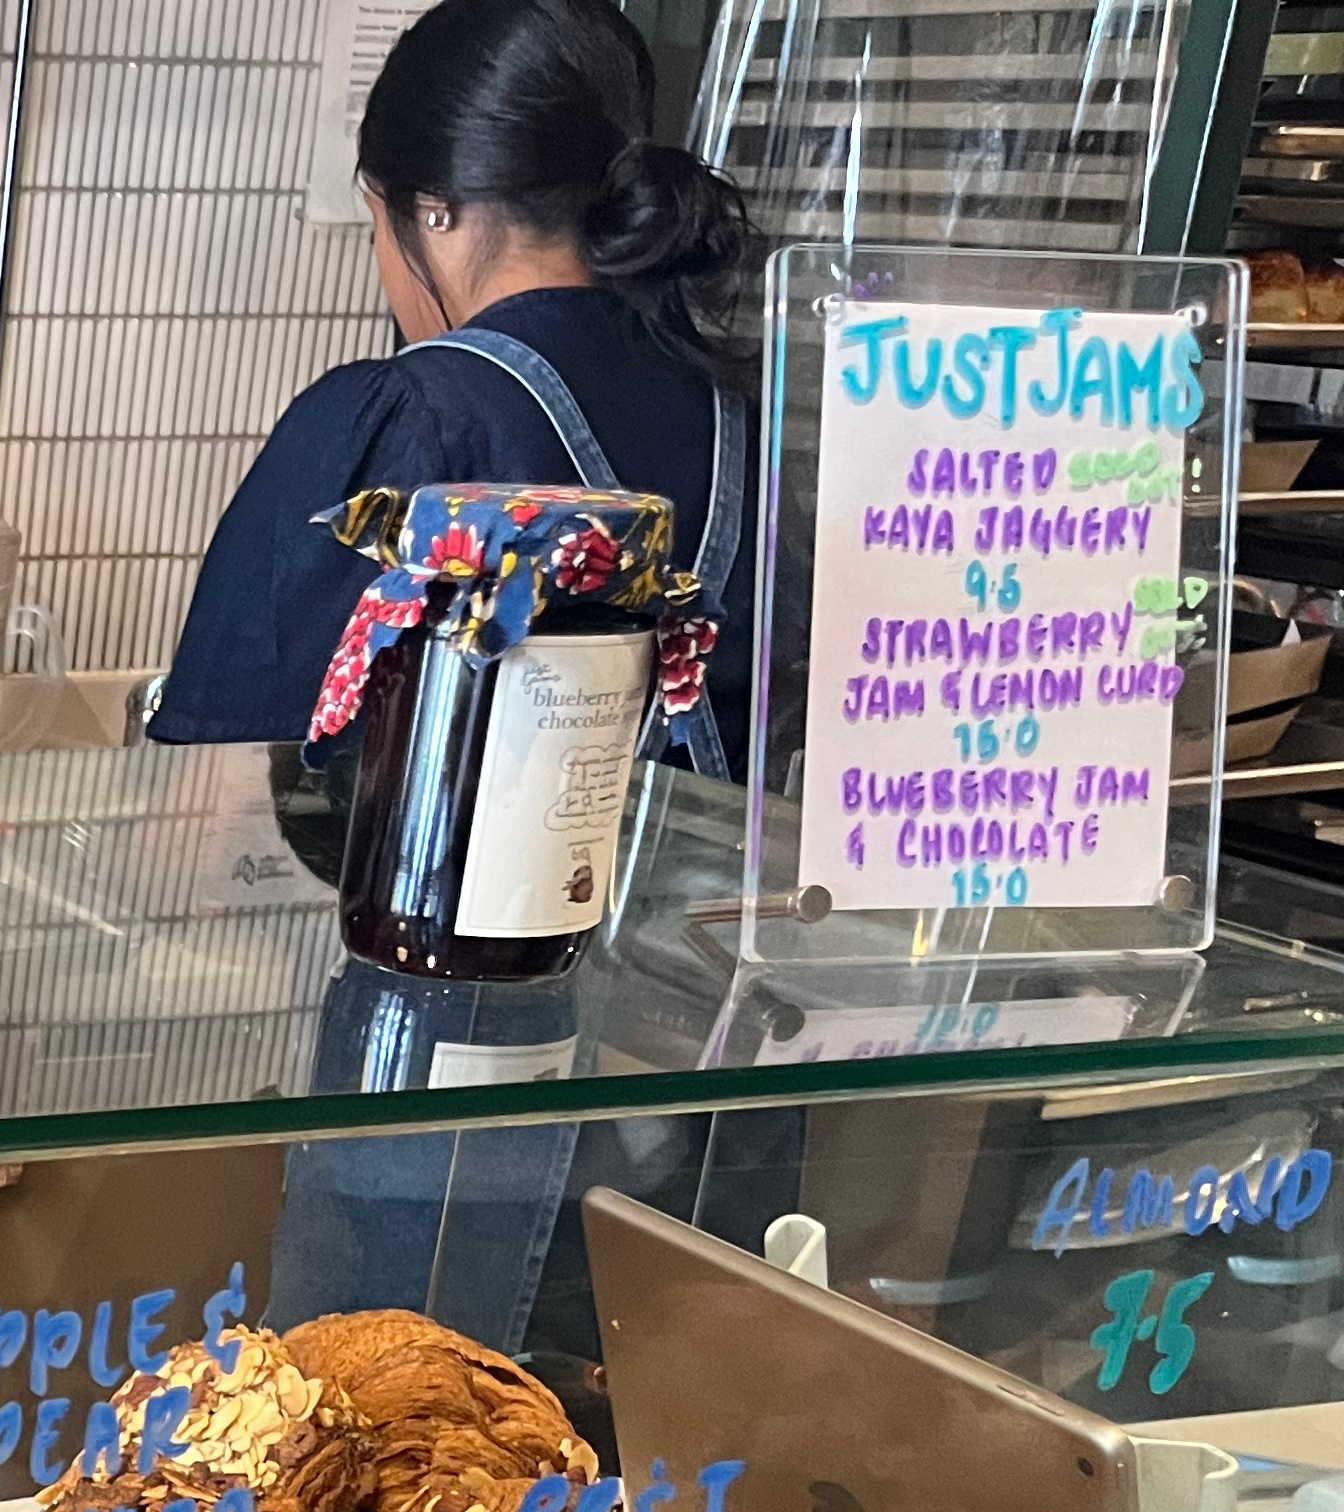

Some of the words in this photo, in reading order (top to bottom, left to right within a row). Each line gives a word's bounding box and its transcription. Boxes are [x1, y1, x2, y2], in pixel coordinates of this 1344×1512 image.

[908, 447, 1058, 495] SALTED
[864, 504, 955, 552] KAYA
[975, 504, 1152, 557] JAGGERY
[861, 601, 1133, 665] STRAWBERRY
[843, 674, 925, 723] JAM
[970, 665, 1084, 718] LEMON
[1097, 661, 1185, 704] CURD
[842, 766, 1058, 822] BLUEBERRY
[1074, 765, 1150, 809] JAM
[896, 814, 1099, 867] CHOCOLATE
[1031, 1147, 1333, 1258] ALMOND
